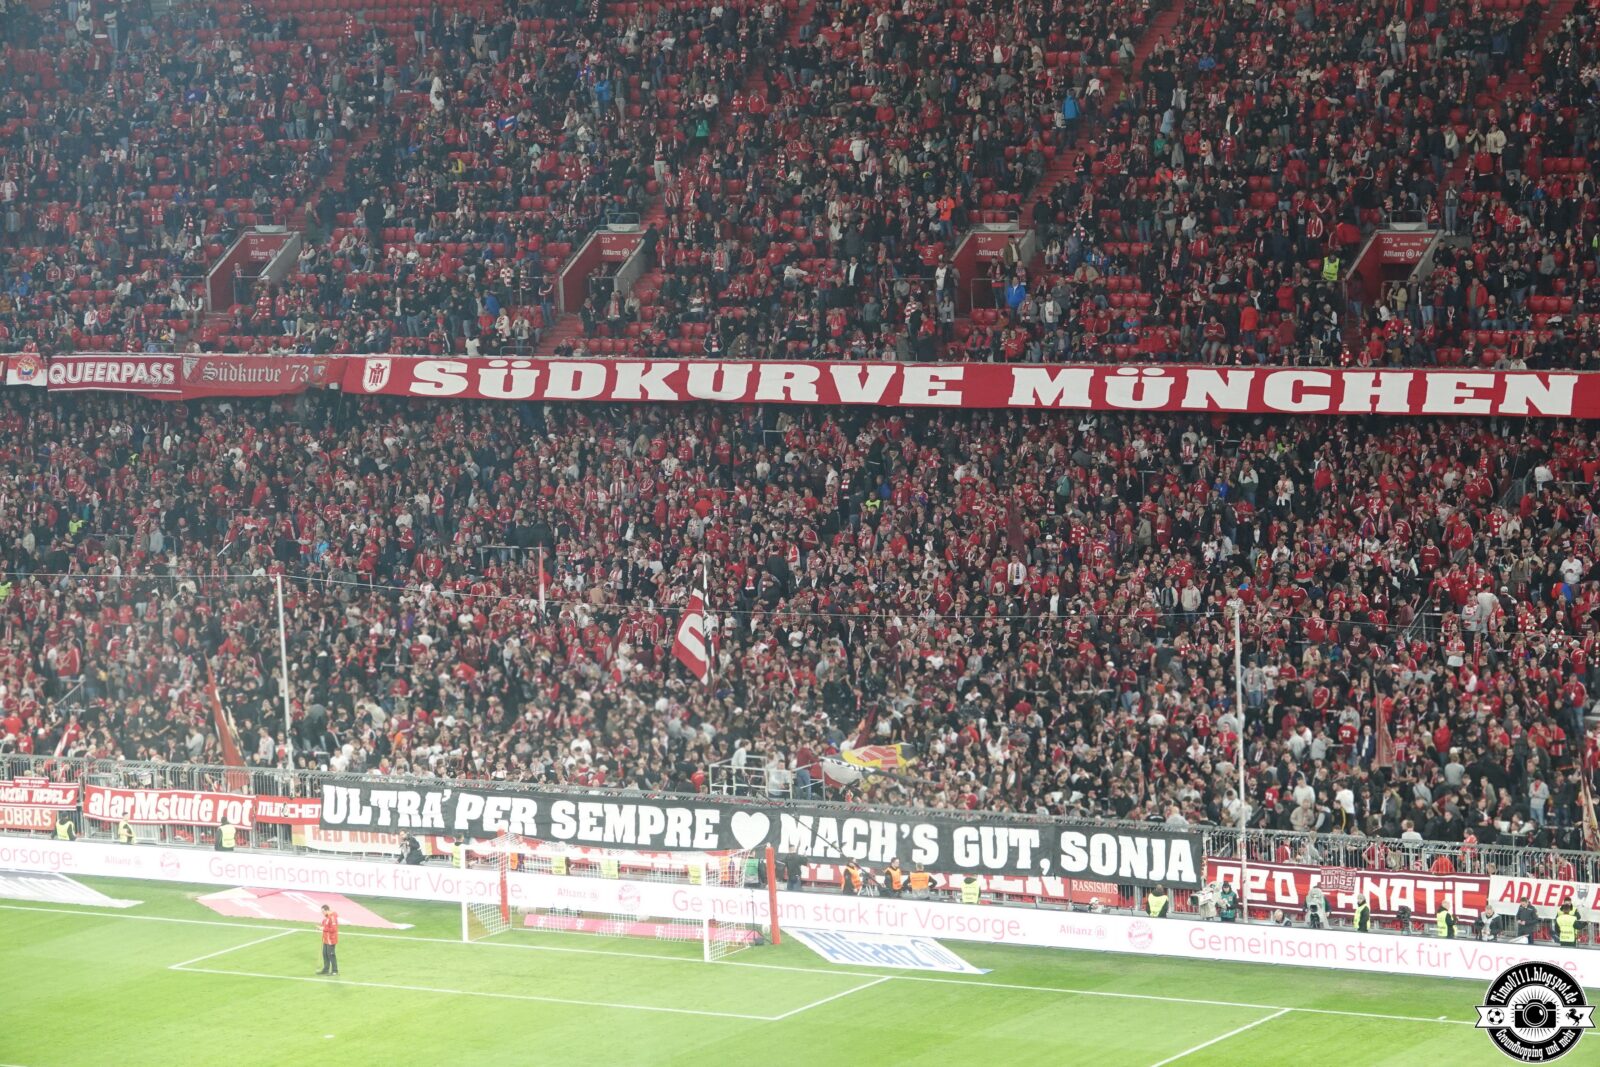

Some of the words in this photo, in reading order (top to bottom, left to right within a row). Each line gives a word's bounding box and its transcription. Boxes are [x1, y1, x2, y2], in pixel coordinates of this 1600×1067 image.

[50, 362, 175, 384] QUEERPASS
[202, 361, 282, 382] Südkurve
[409, 359, 964, 406] SÜDKURVE
[1008, 367, 1579, 416] MÜNCHEN
[88, 789, 214, 822] alarMstufe
[216, 800, 252, 826] rot
[454, 792, 537, 836] PER
[550, 800, 720, 849] SEMPRE
[778, 813, 939, 866] MACH'S
[953, 826, 1050, 876] GUT,
[1060, 831, 1197, 883] SONJA
[209, 856, 329, 886] Gemeinsam
[336, 868, 387, 890] stark
[393, 870, 421, 891] für
[1072, 880, 1118, 895] RASSISMUS
[557, 888, 588, 900] Allianz
[1500, 880, 1575, 908] ADLER
[814, 903, 868, 928] stark
[877, 904, 908, 928] für
[917, 907, 1026, 940] Vorsorge.
[1060, 924, 1092, 936] Allianz
[797, 930, 936, 968] Allianz
[1188, 928, 1336, 960] Gemeinsam
[1346, 941, 1408, 966] stark
[1416, 944, 1452, 968] für
